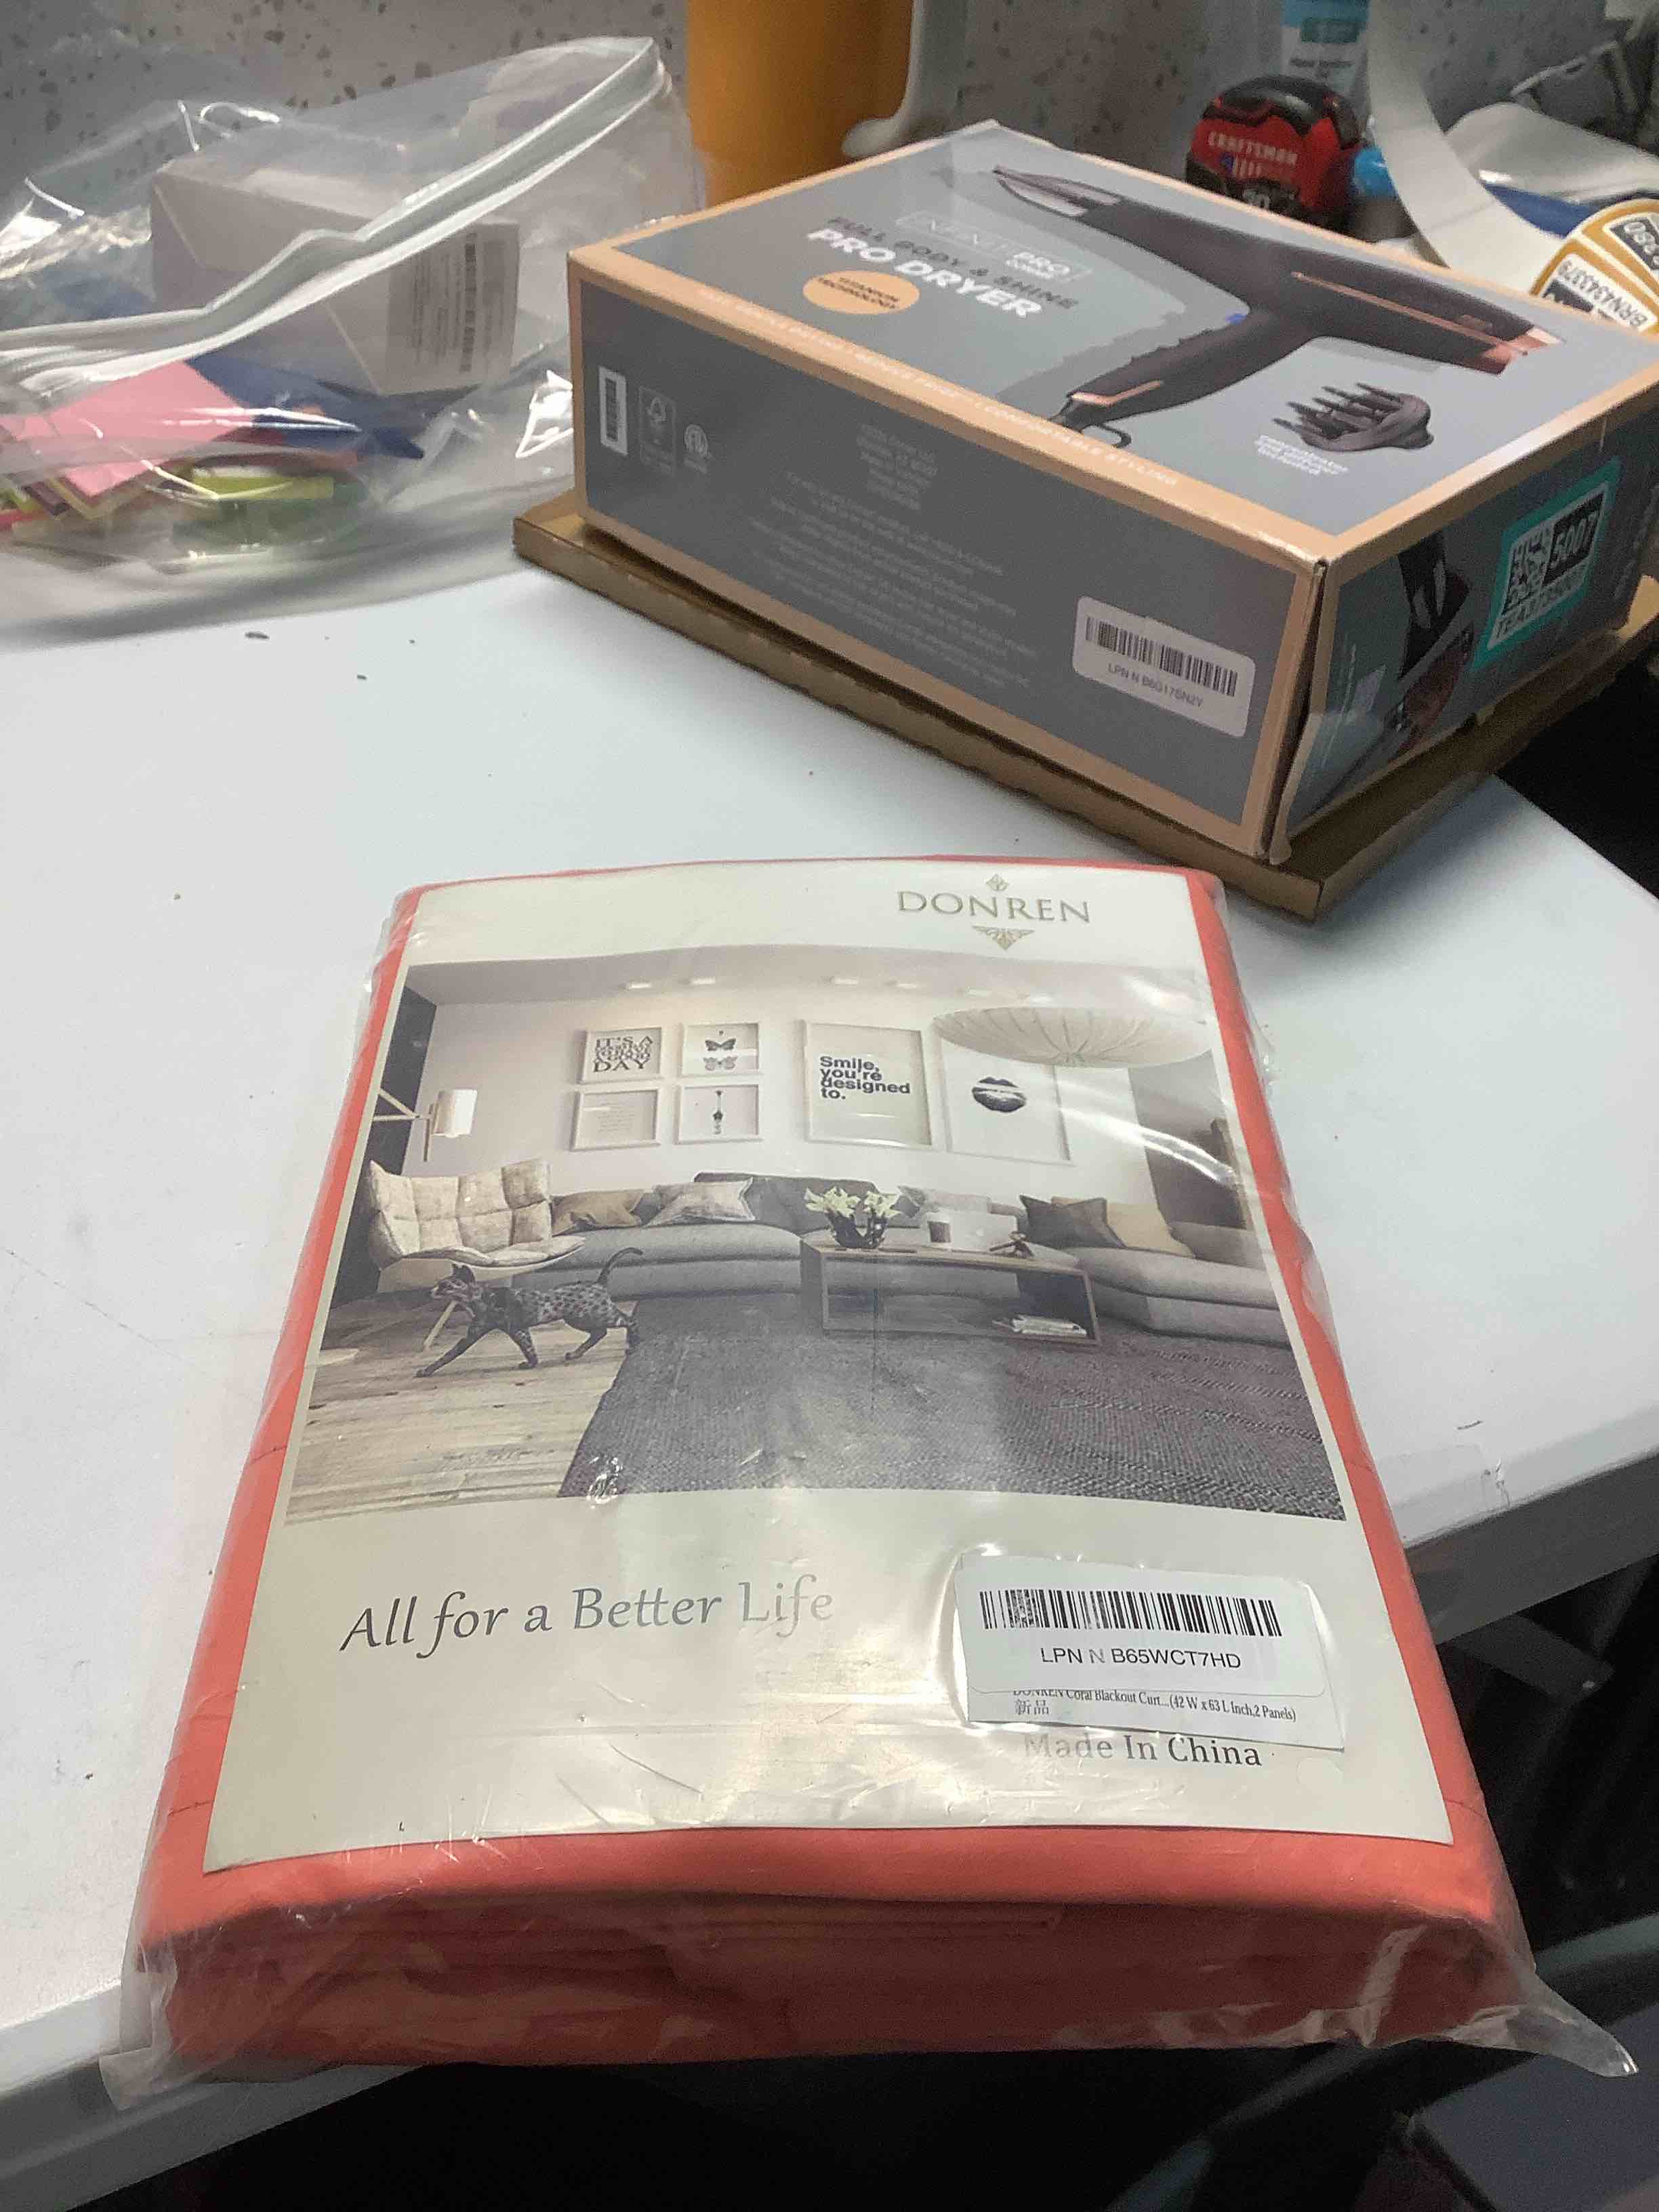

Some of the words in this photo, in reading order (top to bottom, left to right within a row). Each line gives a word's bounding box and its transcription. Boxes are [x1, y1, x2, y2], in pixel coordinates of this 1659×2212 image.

[1206, 131, 1298, 165] CRAFTSMAN
[806, 228, 896, 263] PRO
[893, 260, 1042, 319] DRYER
[897, 890, 1090, 923] DONREN
[593, 1058, 651, 1073] DAY
[819, 1055, 880, 1072] Smile,
[819, 1067, 882, 1082] you're
[820, 1076, 911, 1094] designed
[821, 1088, 846, 1100] to.
[340, 1595, 417, 1652] All
[415, 1591, 509, 1660] for
[523, 1604, 552, 1635] a
[571, 1587, 722, 1630] Better
[737, 1574, 834, 1638] Life
[1040, 1647, 1082, 1664] LPN
[1088, 1647, 1105, 1664] N
[1112, 1647, 1242, 1669] B65WCT7HD
[1013, 1698, 1050, 1715] 新品
[1095, 1689, 1137, 1703] Blackout
[1186, 1696, 1198, 1711] W
[1201, 1701, 1208, 1711] x
[1208, 1698, 1221, 1713] 63
[1222, 1700, 1229, 1713] L
[1263, 1704, 1296, 1723] Panels)
[1024, 1732, 1113, 1761] Made
[1126, 1734, 1155, 1761] In
[1167, 1736, 1263, 1767] China
